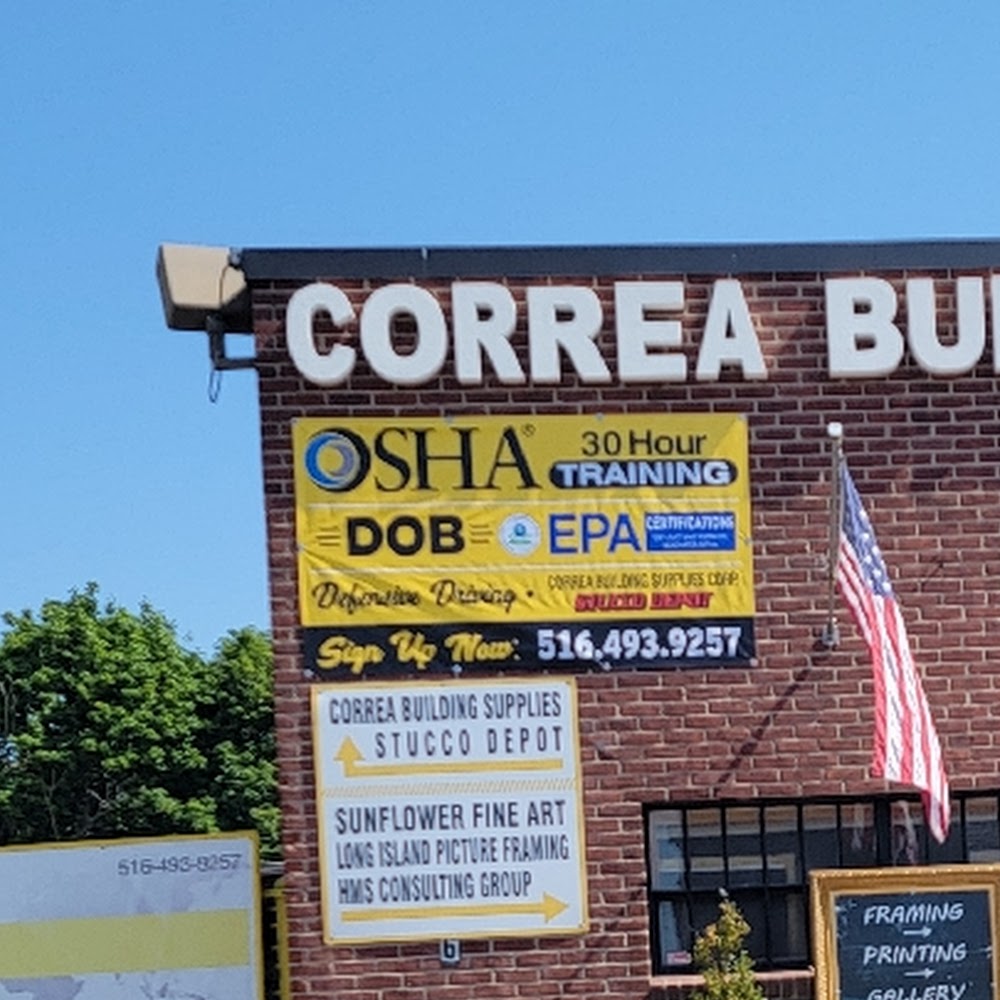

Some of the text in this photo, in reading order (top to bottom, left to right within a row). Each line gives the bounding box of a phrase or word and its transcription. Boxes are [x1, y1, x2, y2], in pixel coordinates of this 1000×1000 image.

[286, 279, 768, 385] CORREA
[582, 429, 707, 456] 30 Hour
[556, 461, 731, 487] TRAINING
[346, 516, 466, 556] DOB
[549, 513, 642, 554] EPA
[311, 579, 518, 614] Defensive Driving
[317, 636, 384, 674] Sign
[389, 631, 436, 669] Up
[537, 627, 741, 661] 516.493.9257
[330, 691, 562, 725] CORREA BUILDING SUPPLIES
[375, 726, 563, 758] STUCCO DEPOT
[335, 800, 566, 835] SUNFLOWER FINE ART
[336, 834, 570, 869] LONG ISLAND PICTURE FRAMING
[338, 871, 532, 904] HMS CONSULTING GROUP
[863, 902, 965, 925] FRAMING
[862, 943, 967, 965] PRINTING
